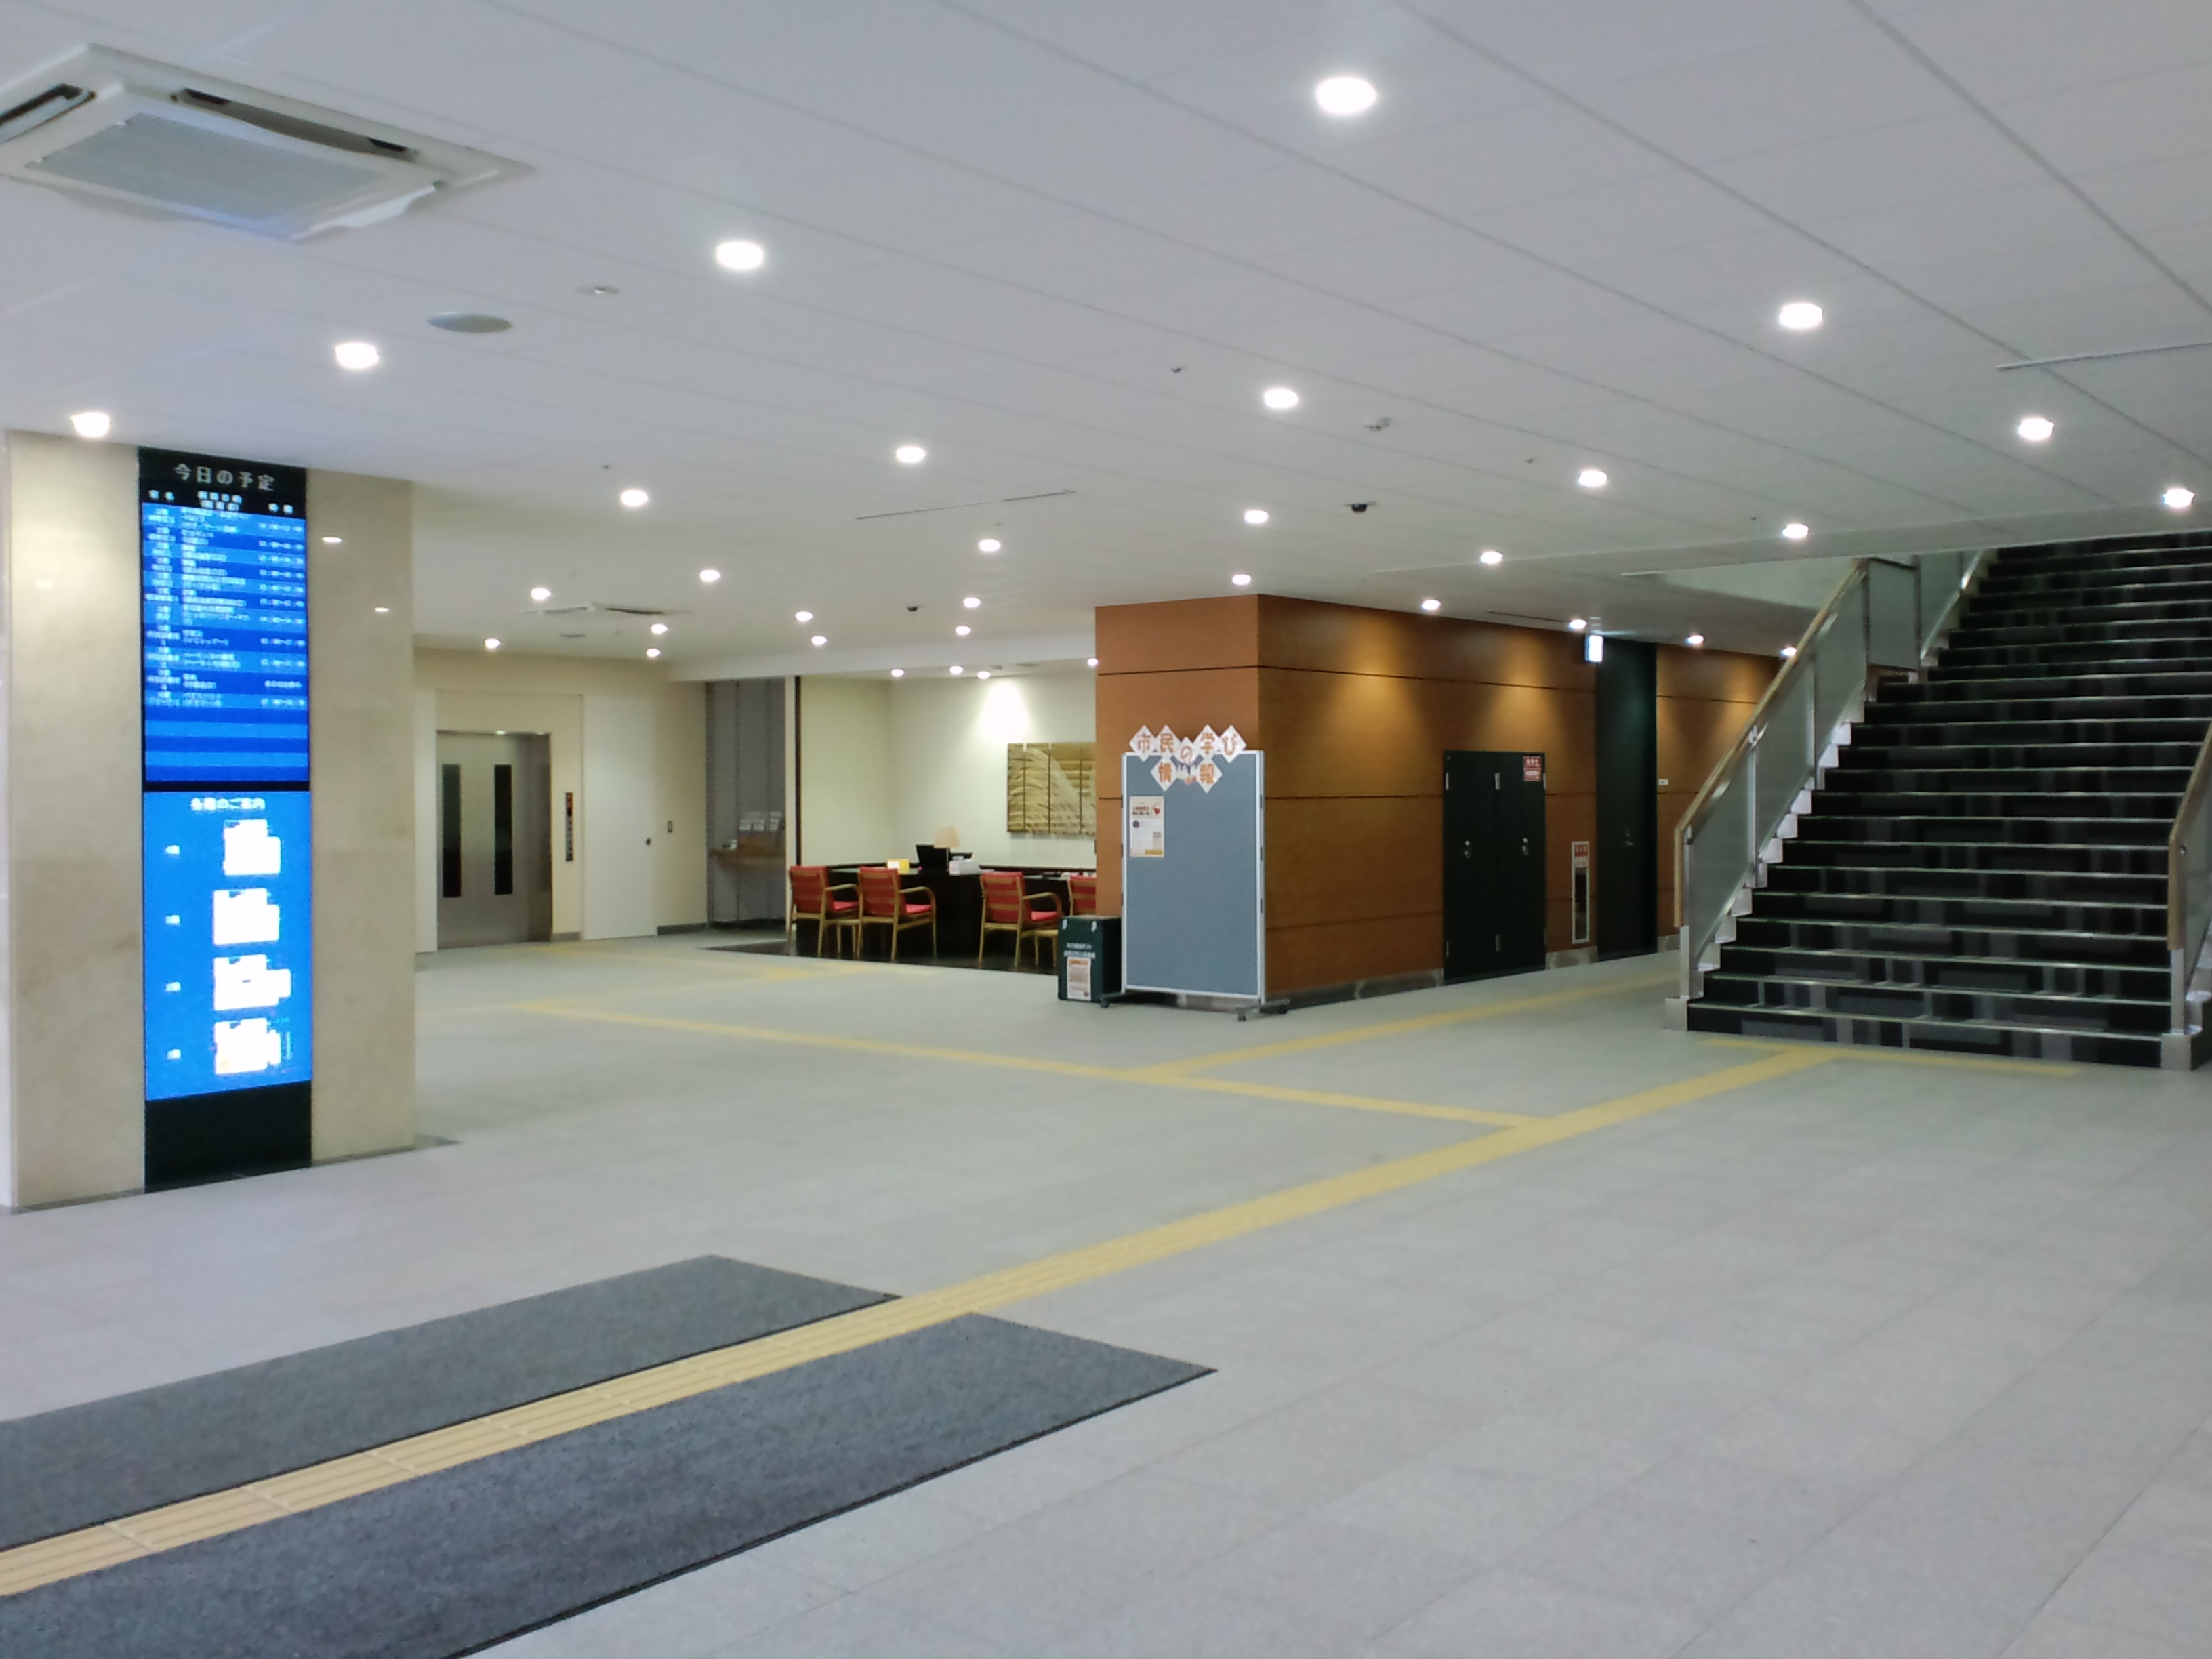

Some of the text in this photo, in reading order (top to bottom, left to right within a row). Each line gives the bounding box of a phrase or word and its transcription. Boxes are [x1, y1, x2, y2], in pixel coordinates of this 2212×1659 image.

[174, 463, 274, 491] 今日の予定
[1137, 733, 1237, 762] 市民の学び
[1158, 762, 1214, 784] 情報
